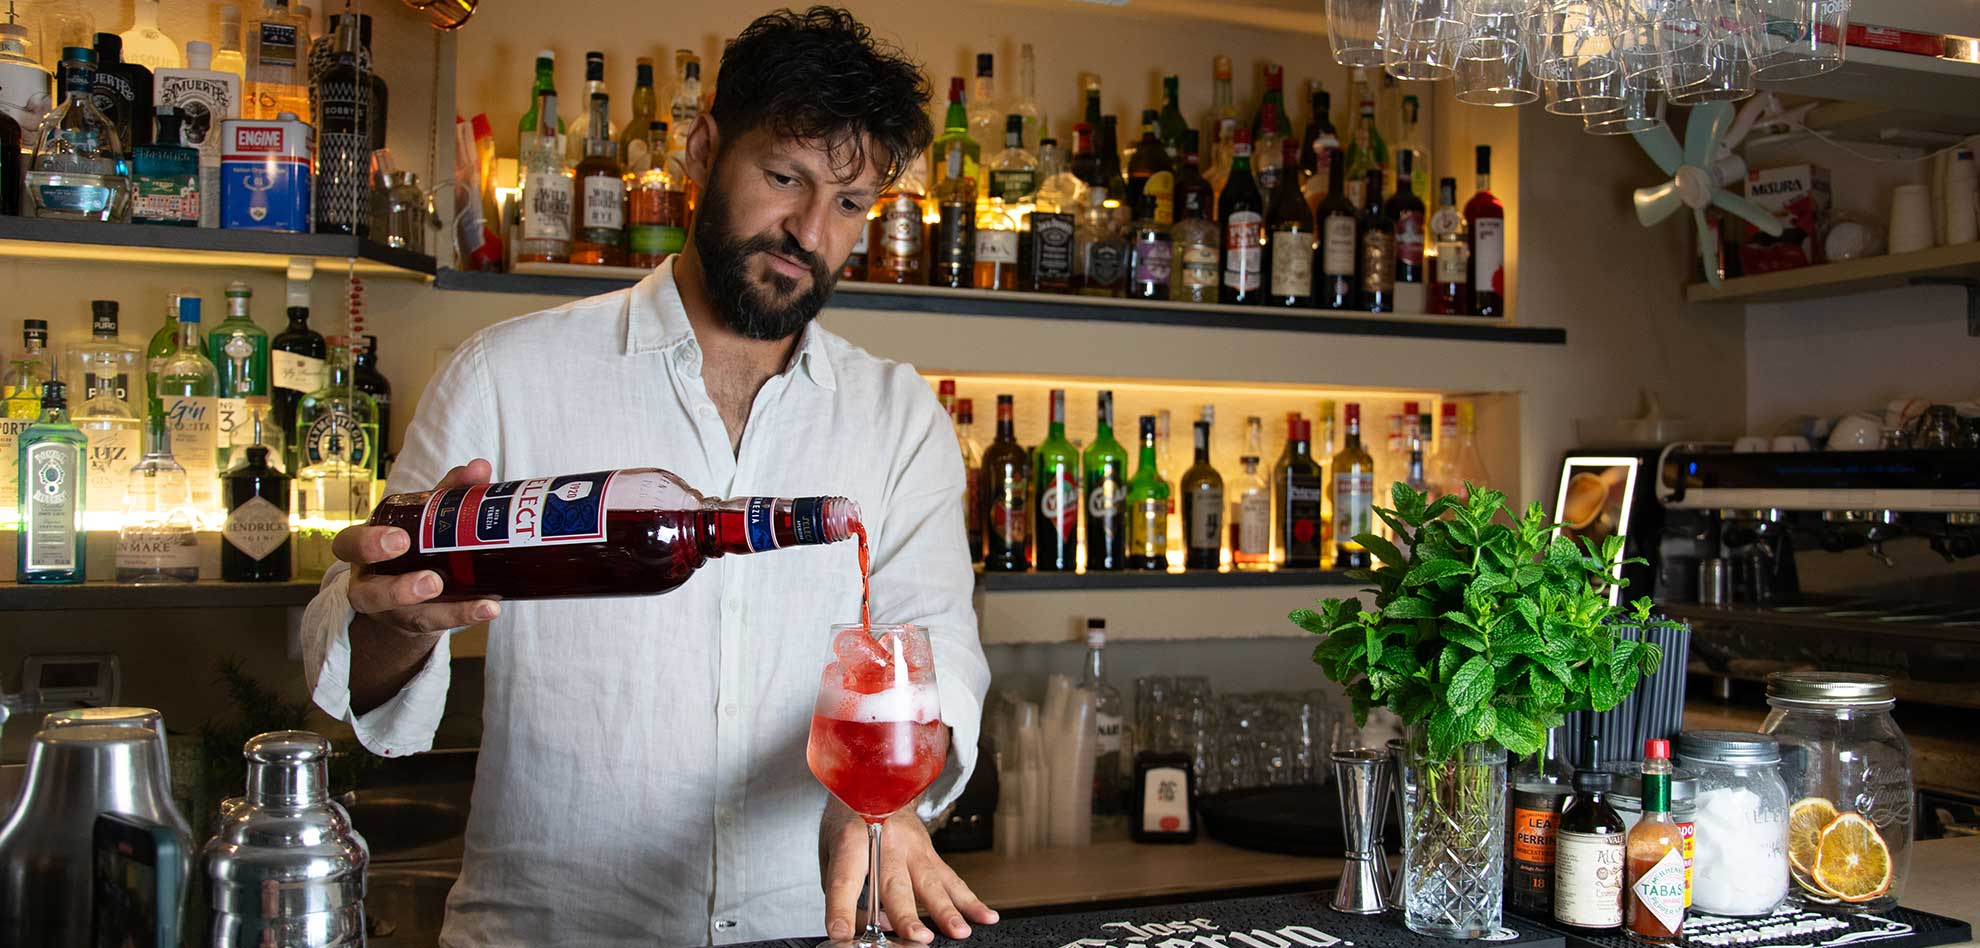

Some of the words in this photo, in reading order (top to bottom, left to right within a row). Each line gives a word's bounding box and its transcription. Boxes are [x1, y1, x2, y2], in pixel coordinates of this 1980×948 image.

[238, 130, 281, 147] ENGINE
[540, 188, 567, 200] WILD
[592, 188, 614, 199] WILD
[592, 211, 613, 222] RYE
[169, 399, 206, 424] Gin
[220, 411, 235, 433] 3
[89, 446, 127, 461] UZ
[566, 482, 582, 499] 1920
[515, 478, 548, 539] ELECT
[751, 498, 763, 524] ENEZIA
[485, 504, 496, 530] VENEZIA
[1529, 818, 1552, 829] LEA
[1517, 832, 1557, 847] PERRIN
[1640, 883, 1682, 897] TABAS
